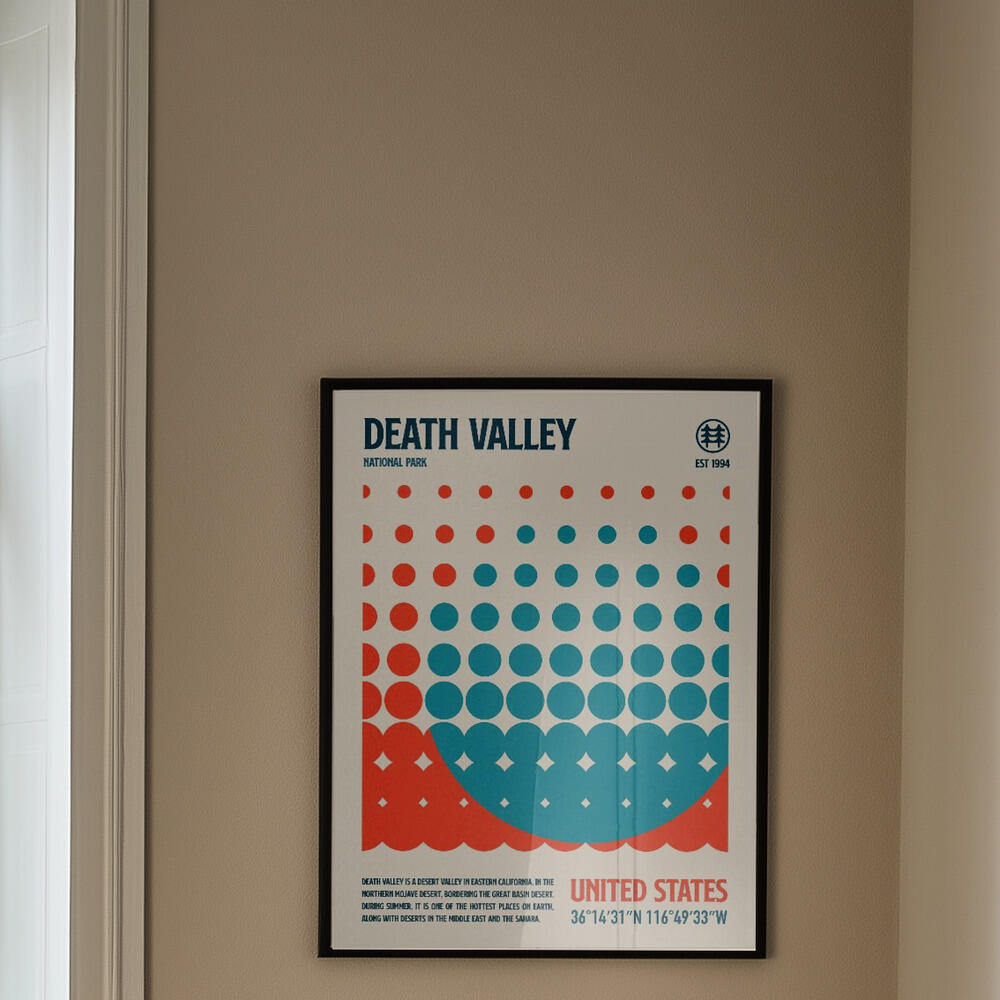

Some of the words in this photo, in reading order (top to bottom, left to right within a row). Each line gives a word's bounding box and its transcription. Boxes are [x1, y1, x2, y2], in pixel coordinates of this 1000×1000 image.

[364, 418, 459, 450] DEATH
[468, 418, 577, 451] VALLEY
[363, 457, 403, 468] NATIONAL
[405, 457, 427, 468] PARK
[696, 458, 710, 468] EST
[711, 458, 730, 468] 1994
[361, 878, 381, 886] DEATH
[382, 878, 404, 886] VALLEY
[405, 878, 411, 886] IS
[411, 878, 417, 886] A
[417, 878, 439, 886] DESERT
[440, 878, 462, 886] VALLEY
[463, 878, 470, 886] IN
[471, 878, 497, 886] EASTERN
[535, 878, 542, 886] IN
[543, 878, 554, 886] THE
[361, 890, 394, 898] NORTHERN
[395, 890, 418, 898] MOJAVE
[444, 890, 477, 898] BORDERING
[479, 890, 491, 898] THE
[492, 890, 510, 898] GREAT
[512, 890, 529, 898] BASIN
[570, 878, 647, 903] UNITED
[653, 878, 729, 903] STATES
[361, 902, 384, 910] DURING
[415, 902, 421, 910] IT
[423, 902, 429, 910] IS
[431, 902, 443, 910] ONE
[445, 902, 454, 910] OF
[456, 902, 467, 910] THE
[469, 902, 496, 910] HOTTEST
[498, 902, 520, 910] PLACES
[522, 902, 531, 910] ON
[361, 915, 381, 923] ALONG
[382, 915, 399, 923] WITH
[400, 915, 426, 923] DESERTS
[427, 915, 434, 923] IN
[436, 915, 447, 923] THE
[448, 915, 470, 923] MIDDLE
[471, 915, 486, 923] EAST
[488, 915, 501, 923] AND
[502, 915, 514, 923] THE
